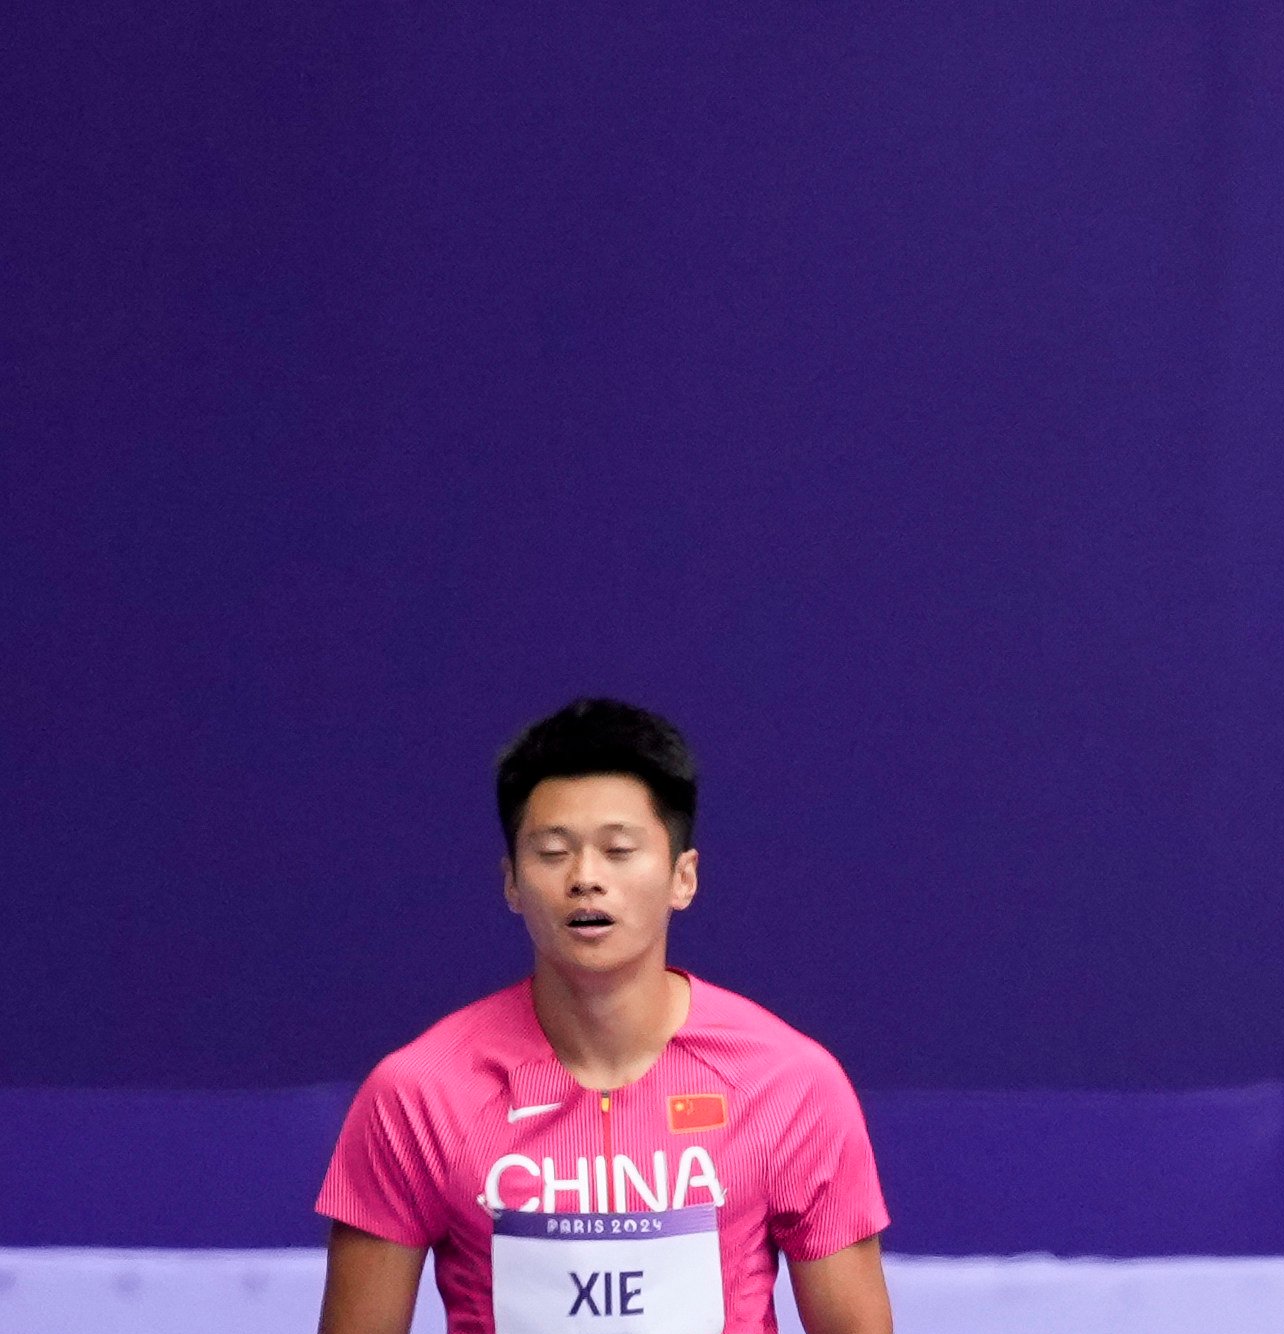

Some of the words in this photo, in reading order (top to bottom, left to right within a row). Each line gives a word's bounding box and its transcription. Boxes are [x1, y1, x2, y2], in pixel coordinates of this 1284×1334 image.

[484, 1146, 725, 1213] CHINA
[546, 1218, 603, 1234] PARIS
[611, 1218, 662, 1234] 2024
[568, 1271, 644, 1317] XIE
